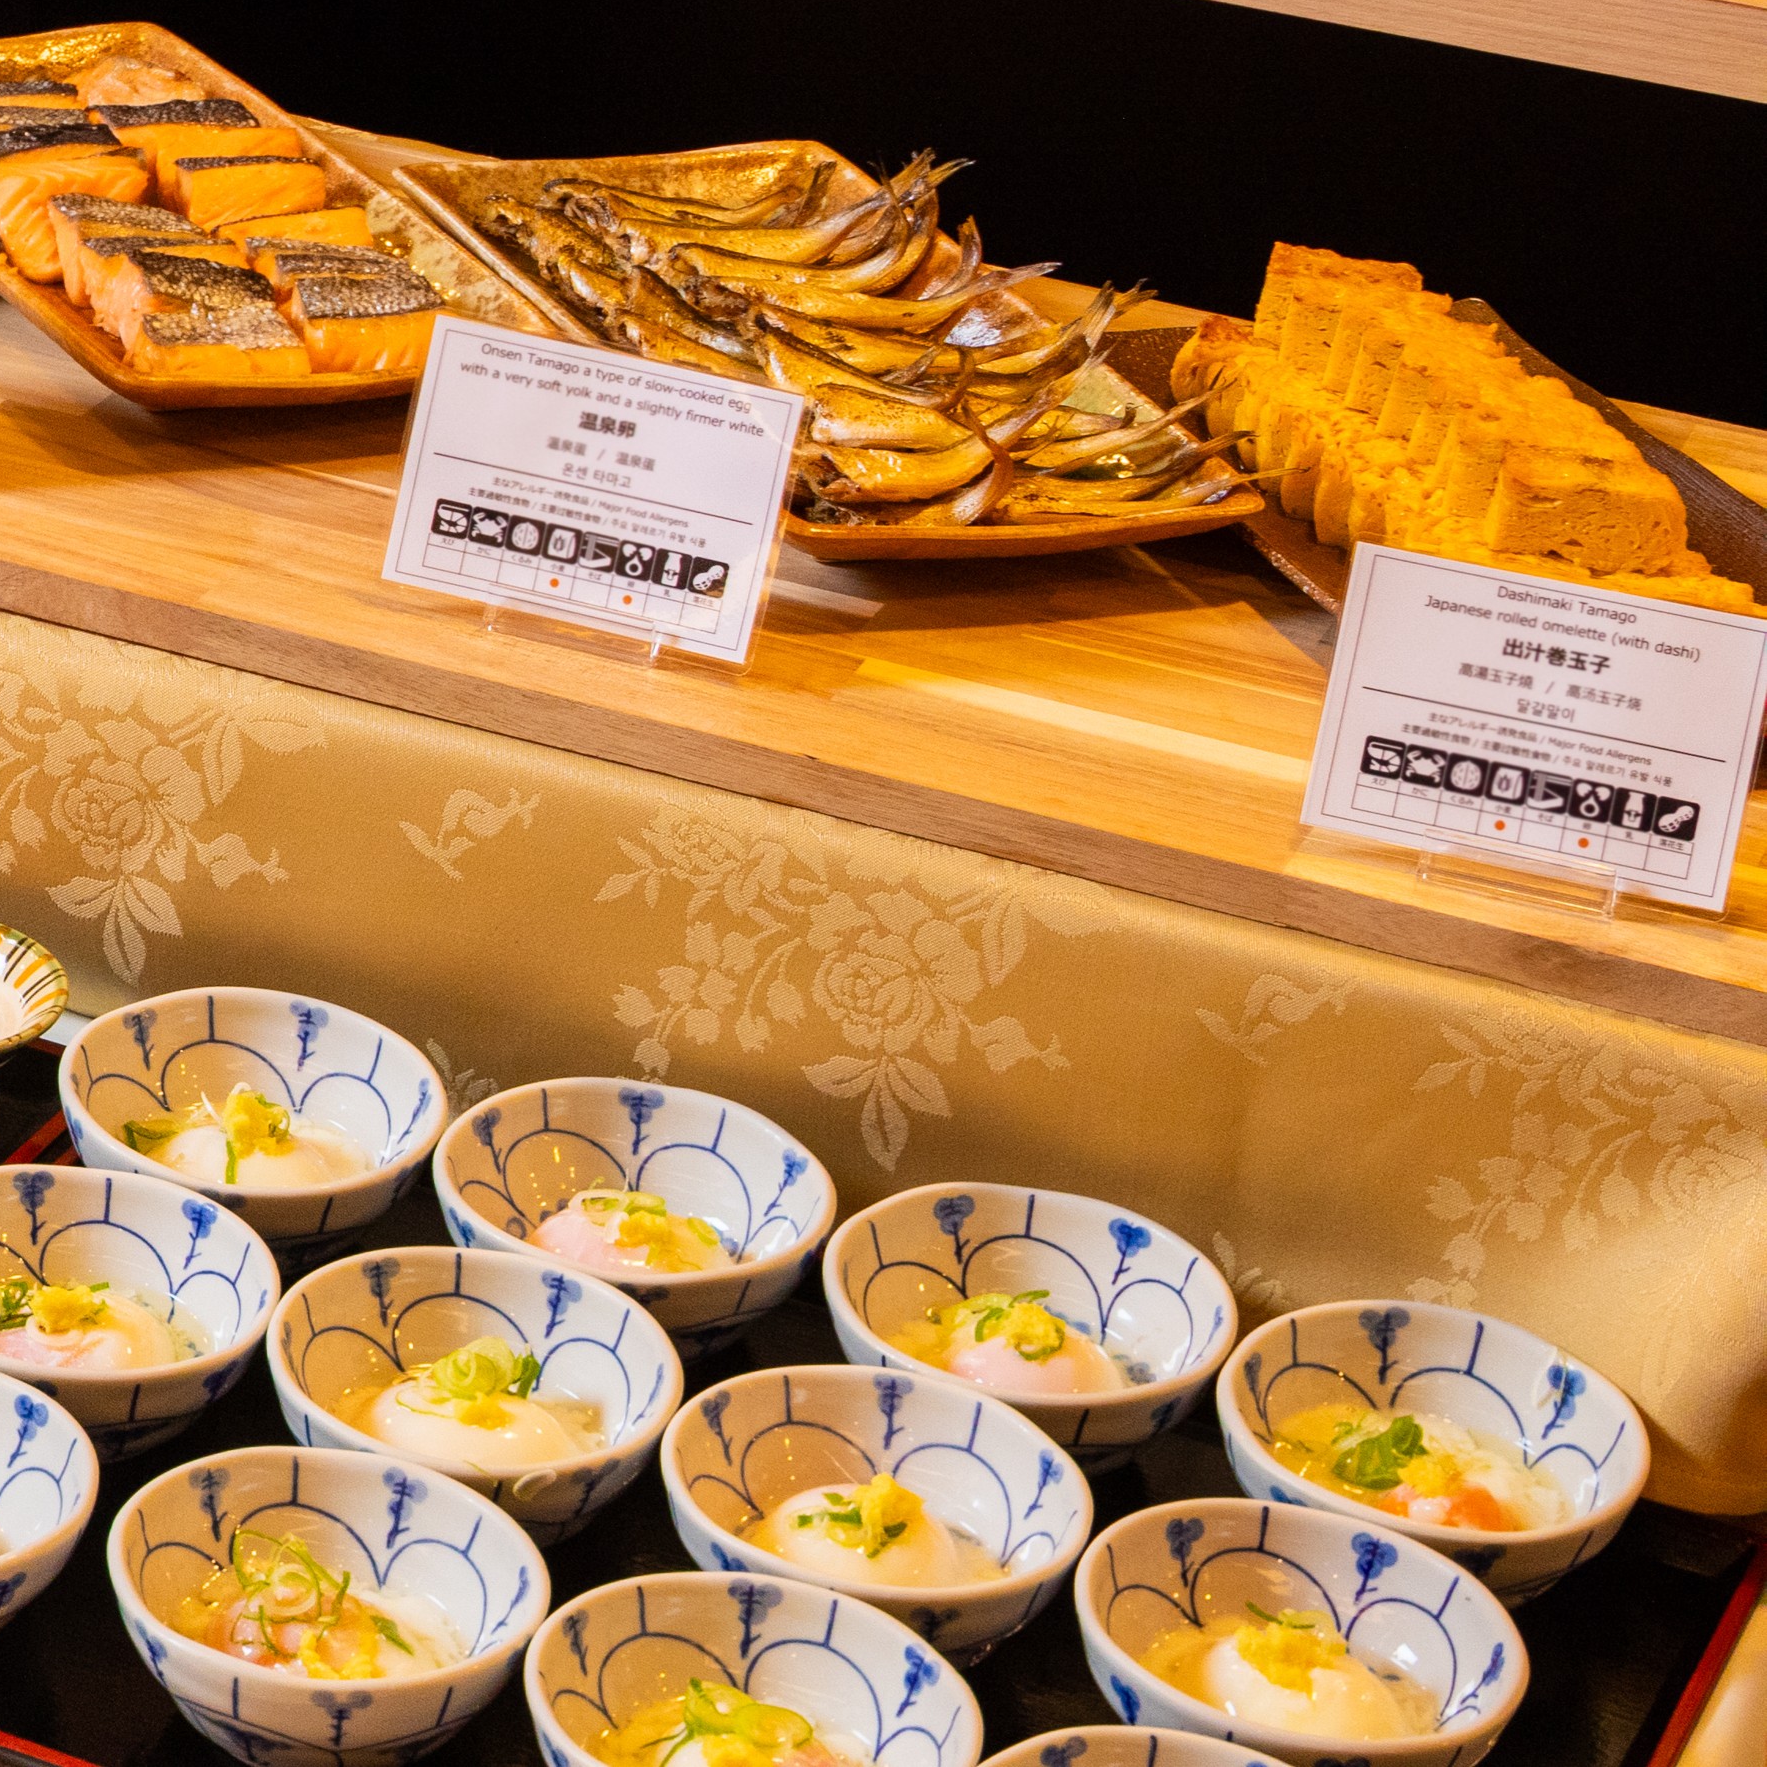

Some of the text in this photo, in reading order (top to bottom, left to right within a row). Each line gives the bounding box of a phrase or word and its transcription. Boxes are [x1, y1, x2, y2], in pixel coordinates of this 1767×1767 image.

[481, 343, 522, 361] Onsen
[528, 353, 579, 374] Tamago
[595, 368, 624, 383] type
[627, 375, 642, 386] of
[644, 380, 724, 405] slow-cooked
[727, 398, 750, 413] egg
[460, 363, 487, 375] with
[504, 372, 532, 387] very
[537, 379, 561, 392] soft
[565, 385, 591, 398] yolk
[595, 391, 620, 405] and
[636, 400, 681, 419] slightly
[685, 409, 724, 427] firmer
[728, 421, 763, 436] white
[579, 412, 635, 437] 温泉卵
[649, 512, 688, 527] Allergens
[1497, 586, 1636, 624] Dashimaki Tamago
[1425, 595, 1700, 662] Japanese rolled omelette (with dashi)
[1502, 638, 1609, 673] 出汁巻玉子
[1547, 737, 1574, 749] Major
[1578, 742, 1603, 755] Food
[1606, 749, 1651, 765] Allergens
